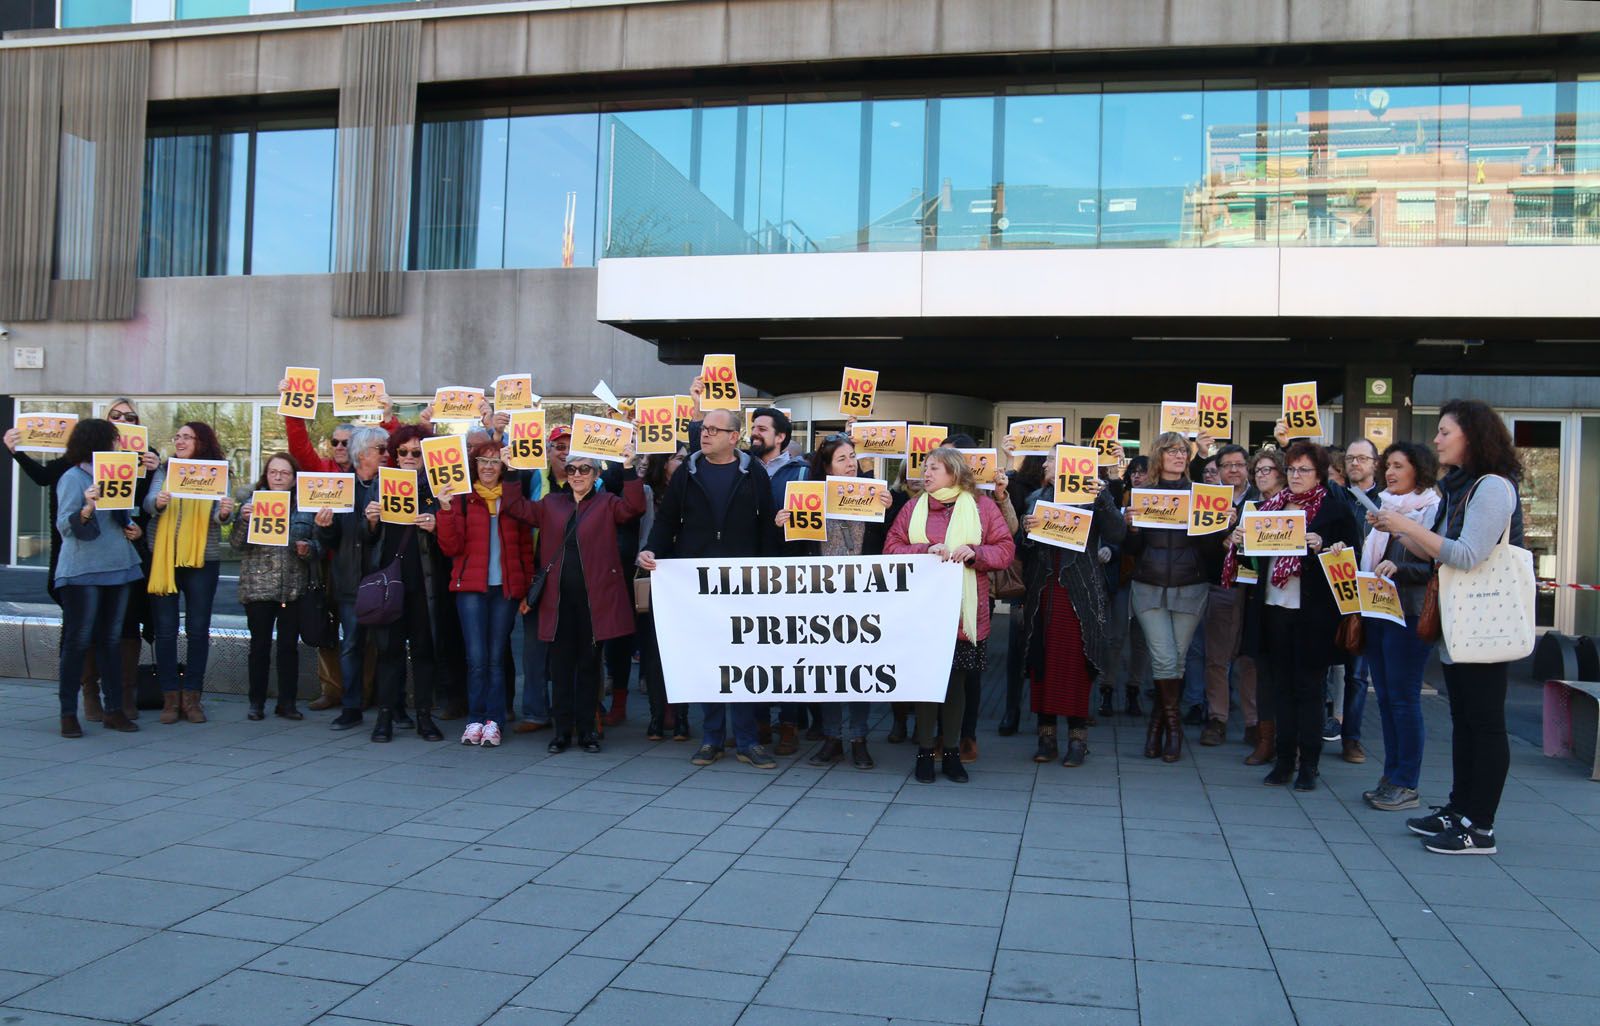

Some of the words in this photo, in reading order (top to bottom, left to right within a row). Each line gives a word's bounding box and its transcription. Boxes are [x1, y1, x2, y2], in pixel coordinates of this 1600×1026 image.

[704, 366, 733, 382] NO
[288, 377, 315, 392] NO
[704, 382, 737, 400] 155
[846, 378, 873, 394] NO
[284, 392, 315, 409] 155
[843, 391, 872, 409] 155
[1200, 394, 1228, 411] NO
[1286, 394, 1314, 410] NO
[641, 408, 672, 424] NO
[676, 418, 690, 432] 15
[1198, 411, 1228, 429] 155
[1284, 410, 1317, 428] 155
[513, 422, 542, 439] NO
[640, 425, 673, 443] 155
[117, 435, 145, 450] NO
[510, 439, 543, 458] 155
[428, 448, 461, 467] NO
[1061, 457, 1094, 475] NO
[99, 463, 134, 480] NO
[429, 464, 465, 486] 155
[97, 480, 132, 498] 155
[383, 479, 414, 496] NO
[255, 502, 286, 517] NO
[382, 495, 415, 514] 155
[788, 493, 821, 511] NO
[1196, 494, 1229, 512] NO
[253, 517, 286, 535] 155
[788, 511, 823, 530] 155
[1193, 510, 1227, 527] 155
[696, 562, 914, 595] LLIBERTAT
[1328, 561, 1356, 581] NO
[1334, 579, 1358, 602] 15
[730, 614, 882, 645] PRESOS
[718, 658, 897, 695] POLÍTICS
